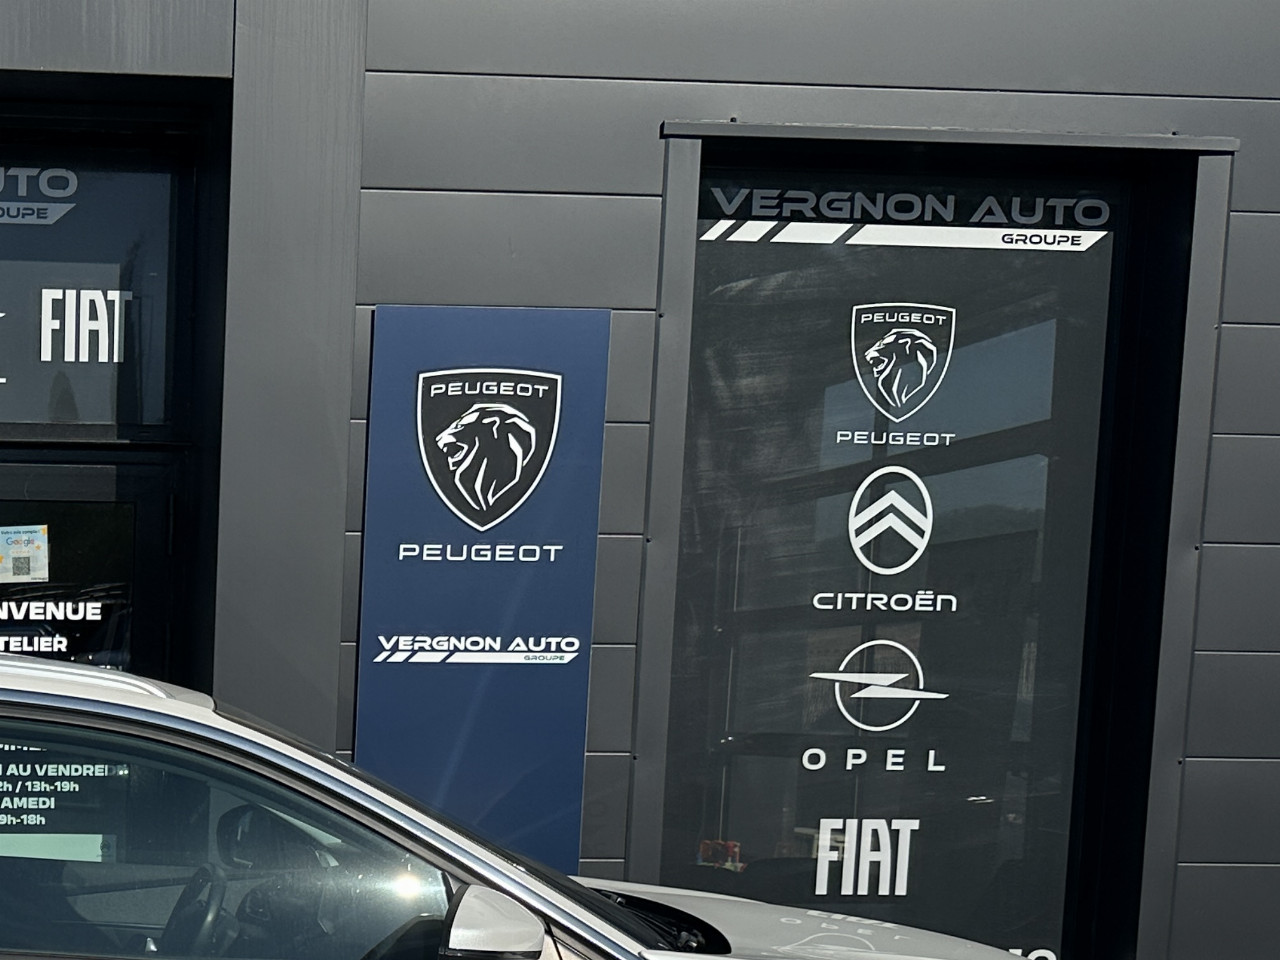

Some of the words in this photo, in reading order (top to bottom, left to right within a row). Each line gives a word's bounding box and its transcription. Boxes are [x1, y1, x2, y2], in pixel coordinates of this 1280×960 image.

[710, 187, 955, 223] VERGNON
[968, 195, 1111, 226] AUTO
[1001, 233, 1083, 247] GROUPE
[40, 288, 133, 363] FIAT
[860, 312, 948, 325] PEUGEOT
[430, 381, 550, 398] PEUGEOT
[836, 430, 956, 446] PEUGEOT
[6, 537, 35, 547] Google
[398, 543, 564, 562] PEUGEOT
[377, 635, 501, 651] VERGNON
[506, 637, 580, 652] AUTO
[523, 654, 566, 662] GROUPE
[801, 748, 946, 771] OPEL
[6, 764, 32, 776] AU
[16, 780, 22, 793] /
[24, 780, 80, 792] 13h-19h
[814, 818, 920, 896] FIAT
